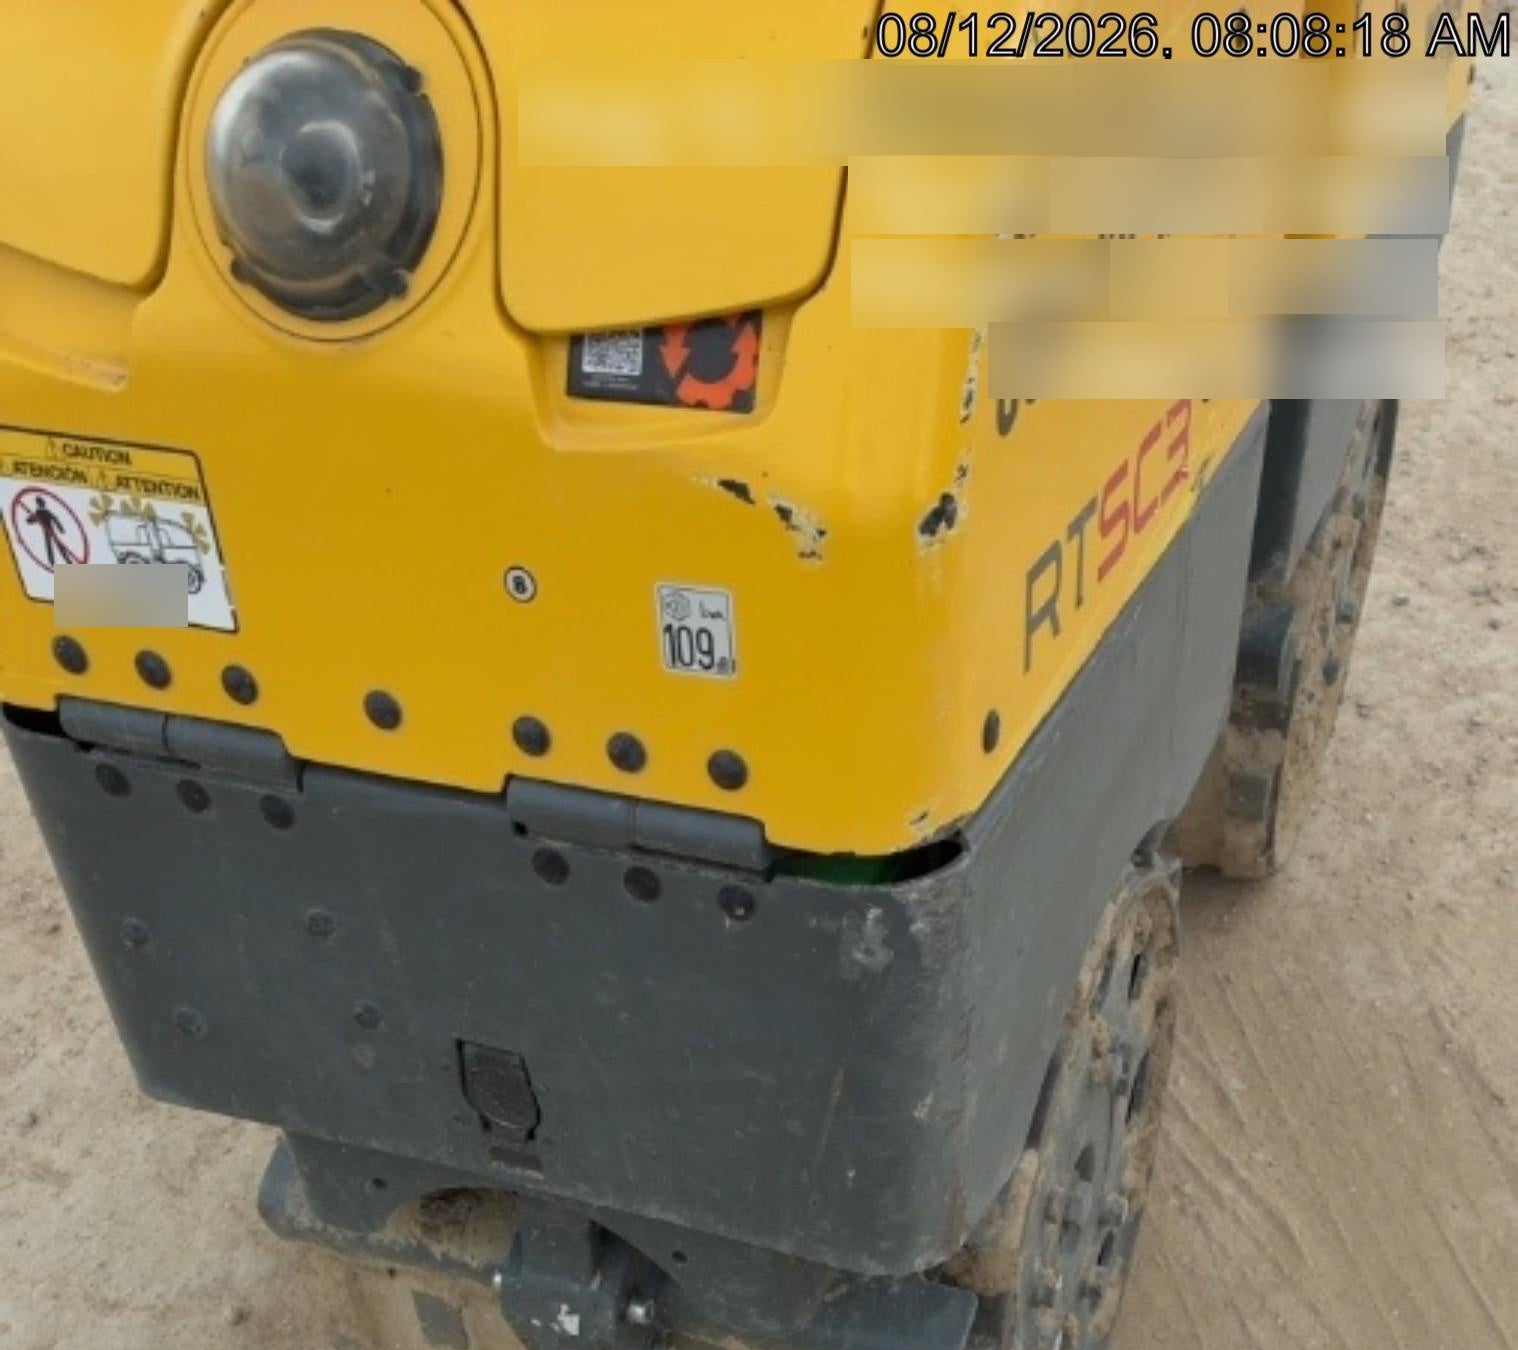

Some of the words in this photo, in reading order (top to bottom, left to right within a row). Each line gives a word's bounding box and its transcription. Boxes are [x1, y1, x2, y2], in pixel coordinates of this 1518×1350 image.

[62, 443, 132, 465] CAUTION
[116, 475, 200, 500] ATTENTION
[663, 624, 715, 670] 109
